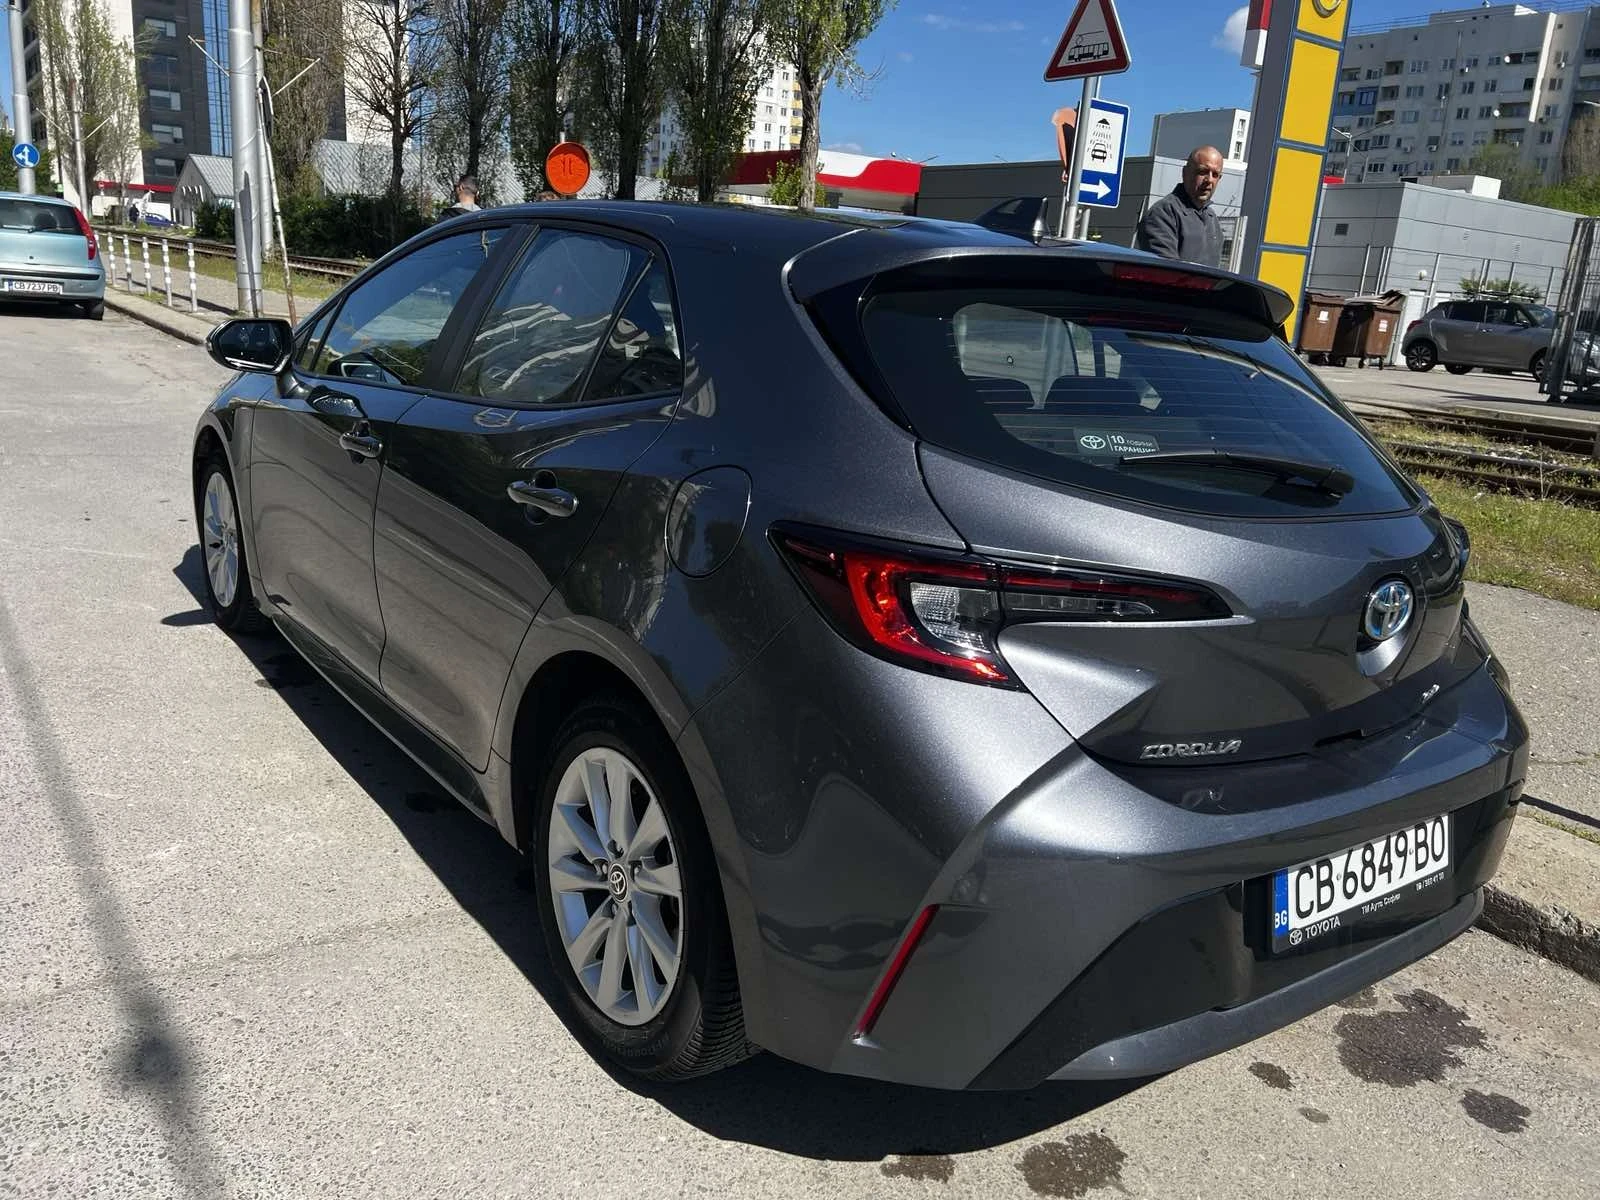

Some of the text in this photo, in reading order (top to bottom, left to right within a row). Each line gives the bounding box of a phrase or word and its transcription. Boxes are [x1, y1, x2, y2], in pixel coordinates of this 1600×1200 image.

[14, 281, 25, 290] CB
[1111, 435, 1125, 444] 10
[1139, 739, 1242, 760] COROLLA
[1295, 859, 1335, 919] CB
[1342, 830, 1408, 900] 6849
[1275, 910, 1288, 928] BG
[1305, 916, 1341, 940] TOYOTA
